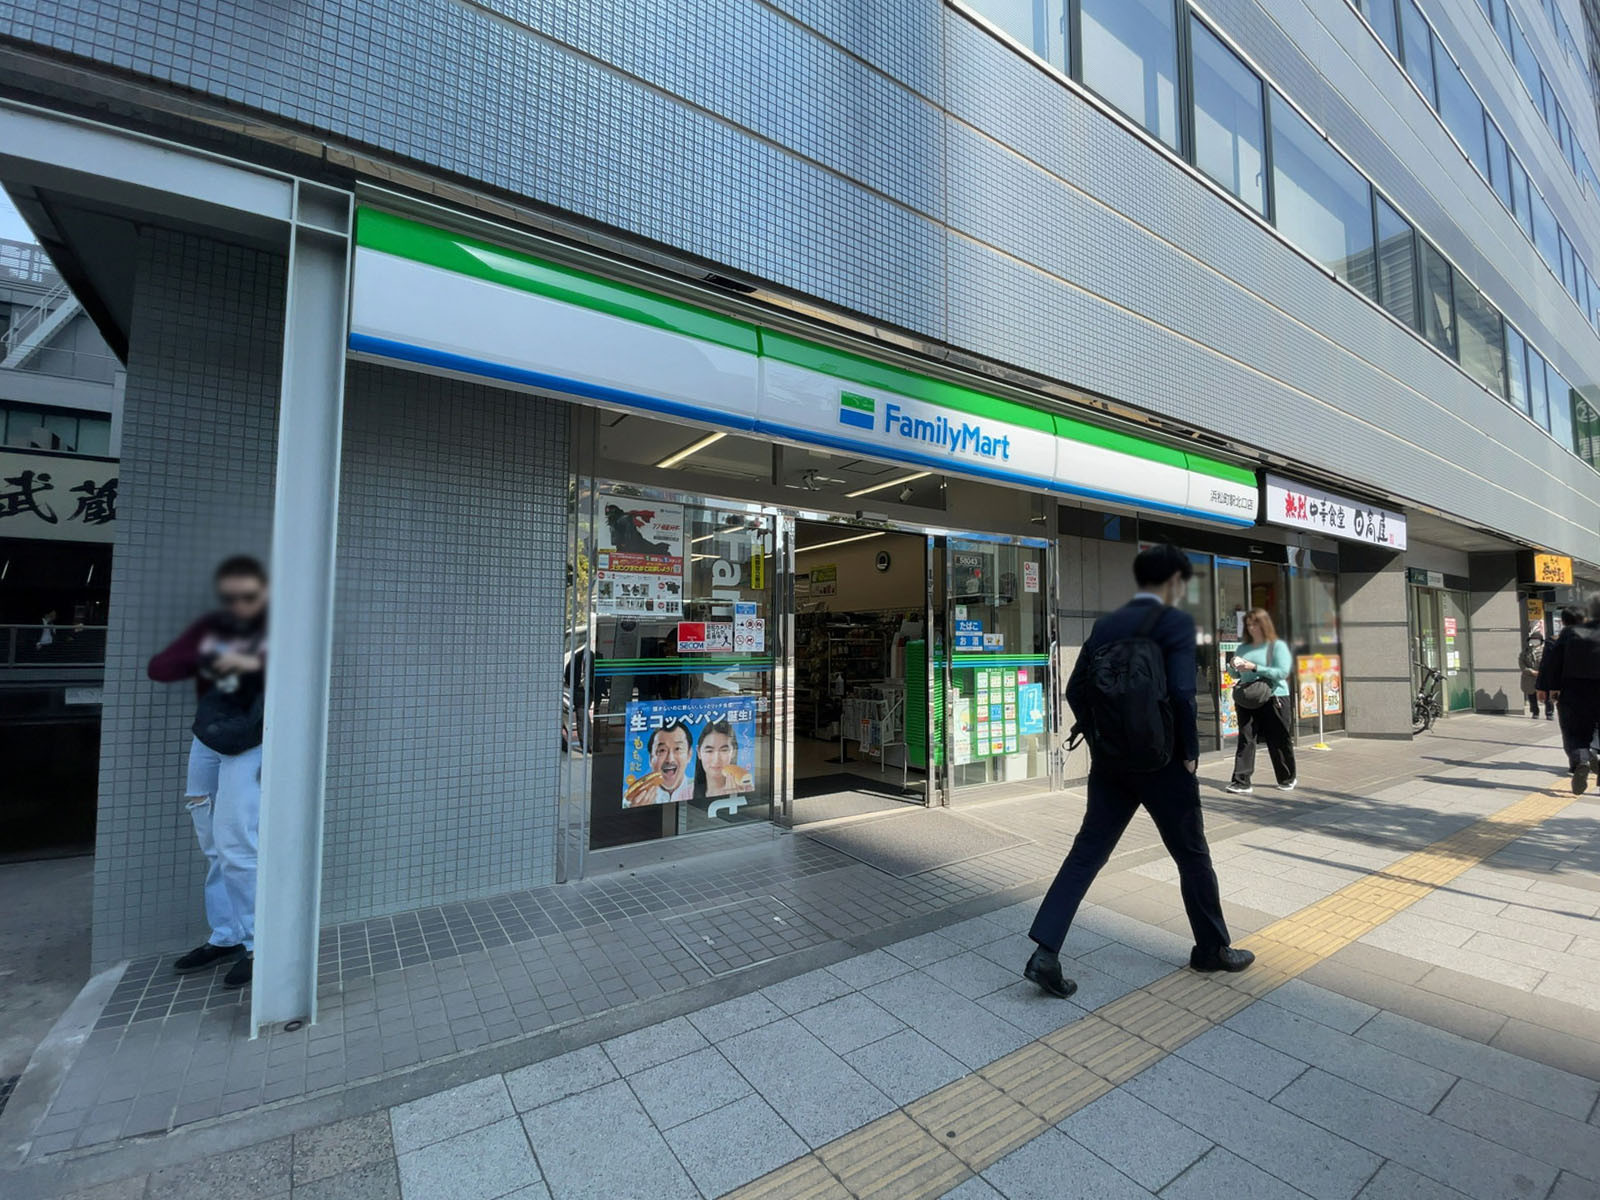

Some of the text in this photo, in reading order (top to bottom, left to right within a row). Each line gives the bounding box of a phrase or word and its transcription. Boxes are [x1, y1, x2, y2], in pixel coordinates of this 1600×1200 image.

[885, 403, 1010, 459] FamilyMart
[960, 621, 979, 631] たばこ
[679, 642, 704, 650] SECOM
[630, 710, 752, 732] 生コッペパン誕生!
